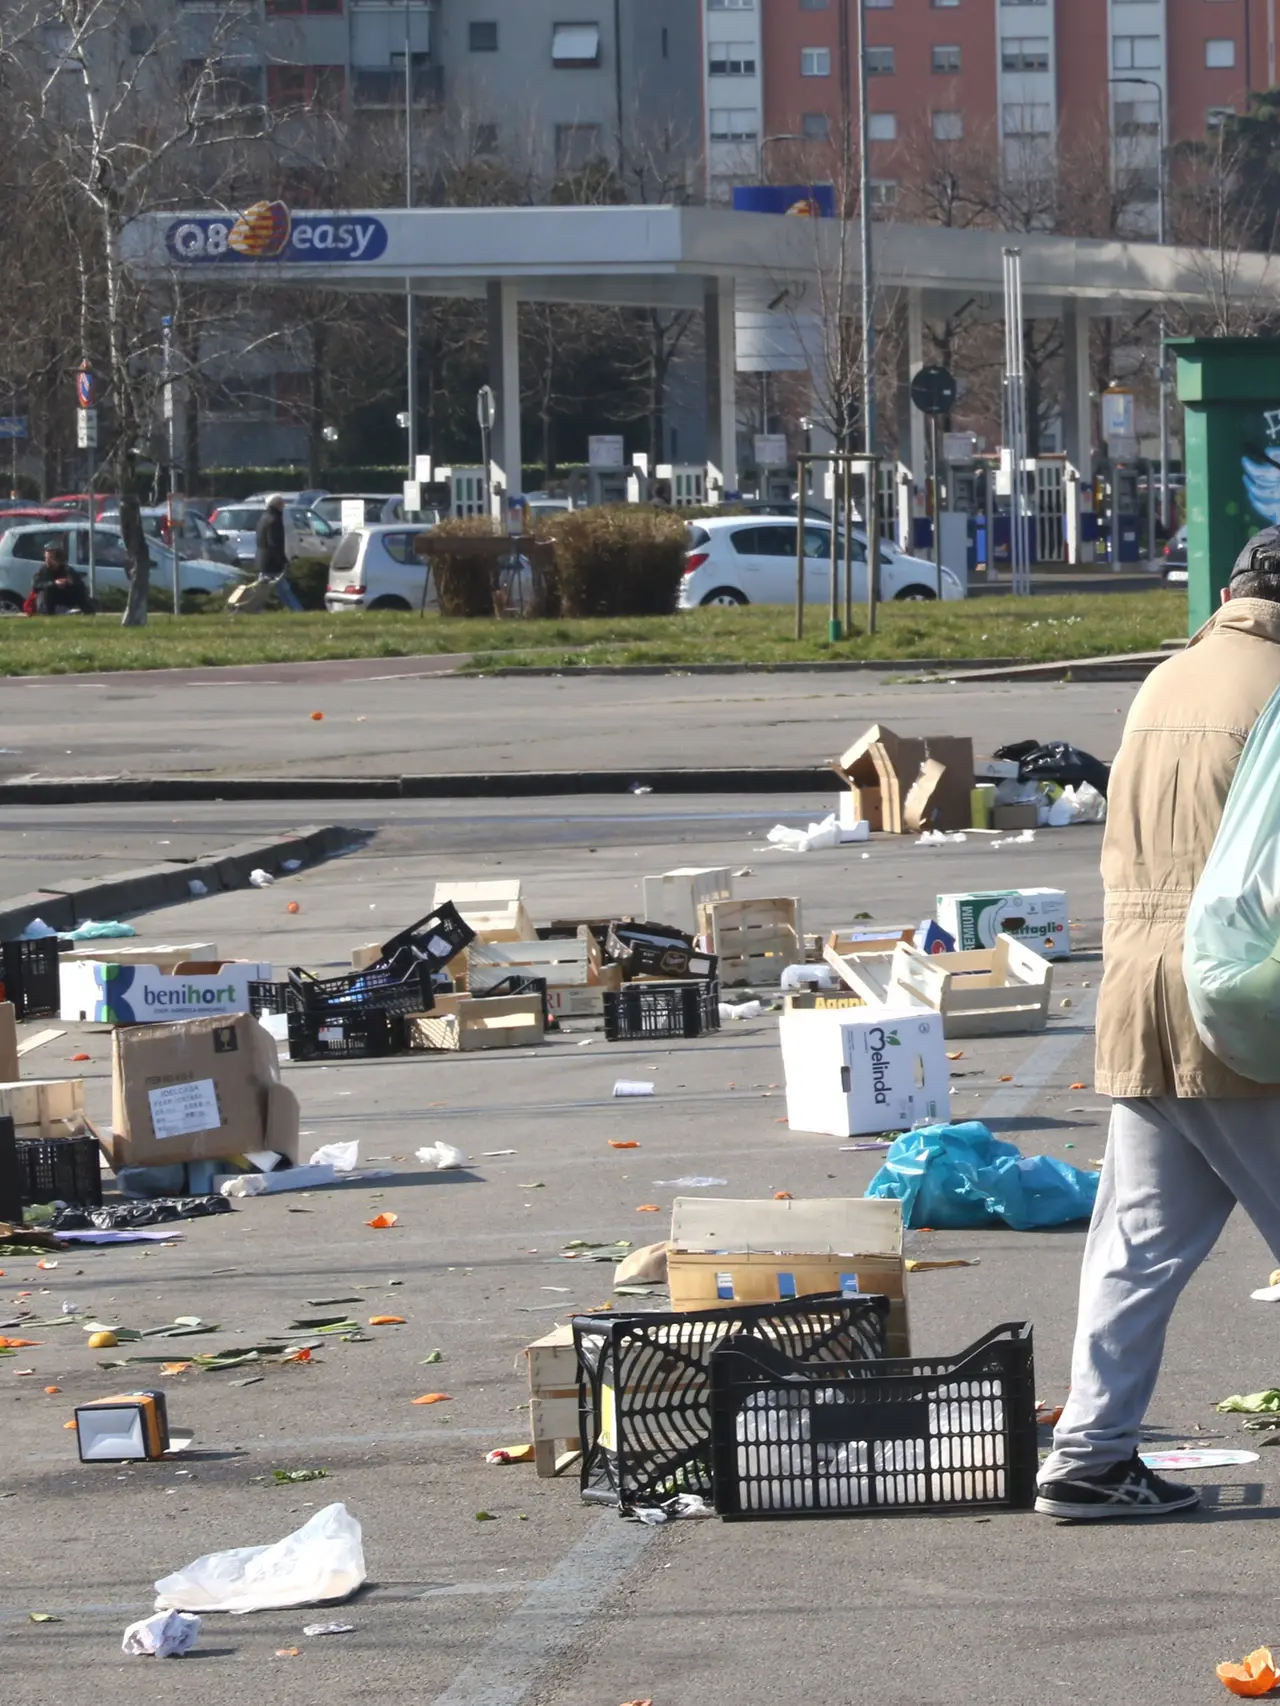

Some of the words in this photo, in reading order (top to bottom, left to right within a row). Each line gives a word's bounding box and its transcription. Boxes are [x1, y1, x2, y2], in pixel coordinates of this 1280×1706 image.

[174, 223, 228, 257] Q8
[292, 223, 376, 258] easy
[962, 905, 976, 951] REMIUM
[143, 984, 237, 1006] benihort
[868, 1027, 893, 1105] Melinda
